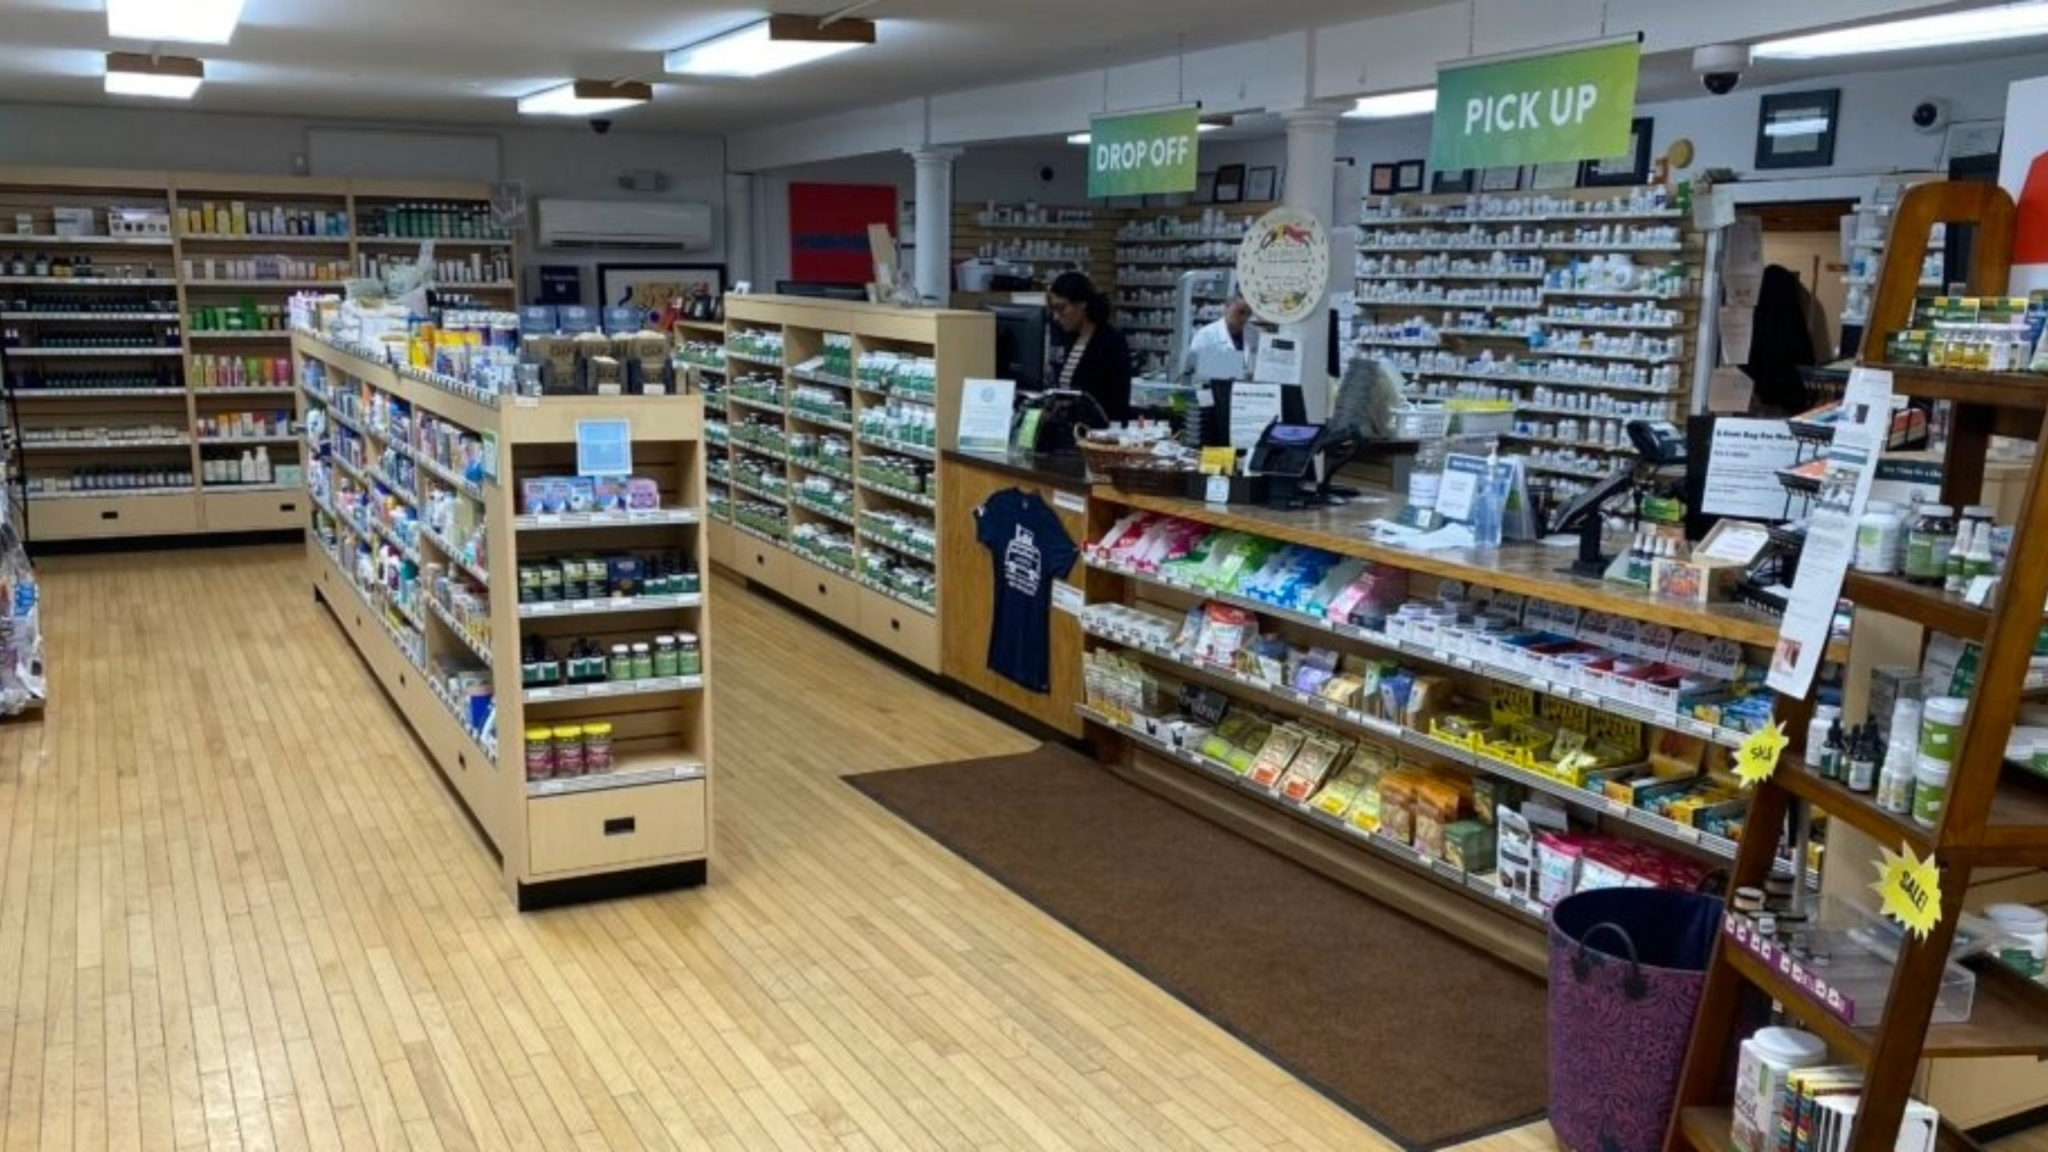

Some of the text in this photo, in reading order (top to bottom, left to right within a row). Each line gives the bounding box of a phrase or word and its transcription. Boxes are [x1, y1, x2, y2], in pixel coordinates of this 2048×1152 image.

[1464, 84, 1597, 135] PICK UP
[1096, 136, 1189, 171] DROP OFF
[1899, 870, 1928, 911] SALE!
